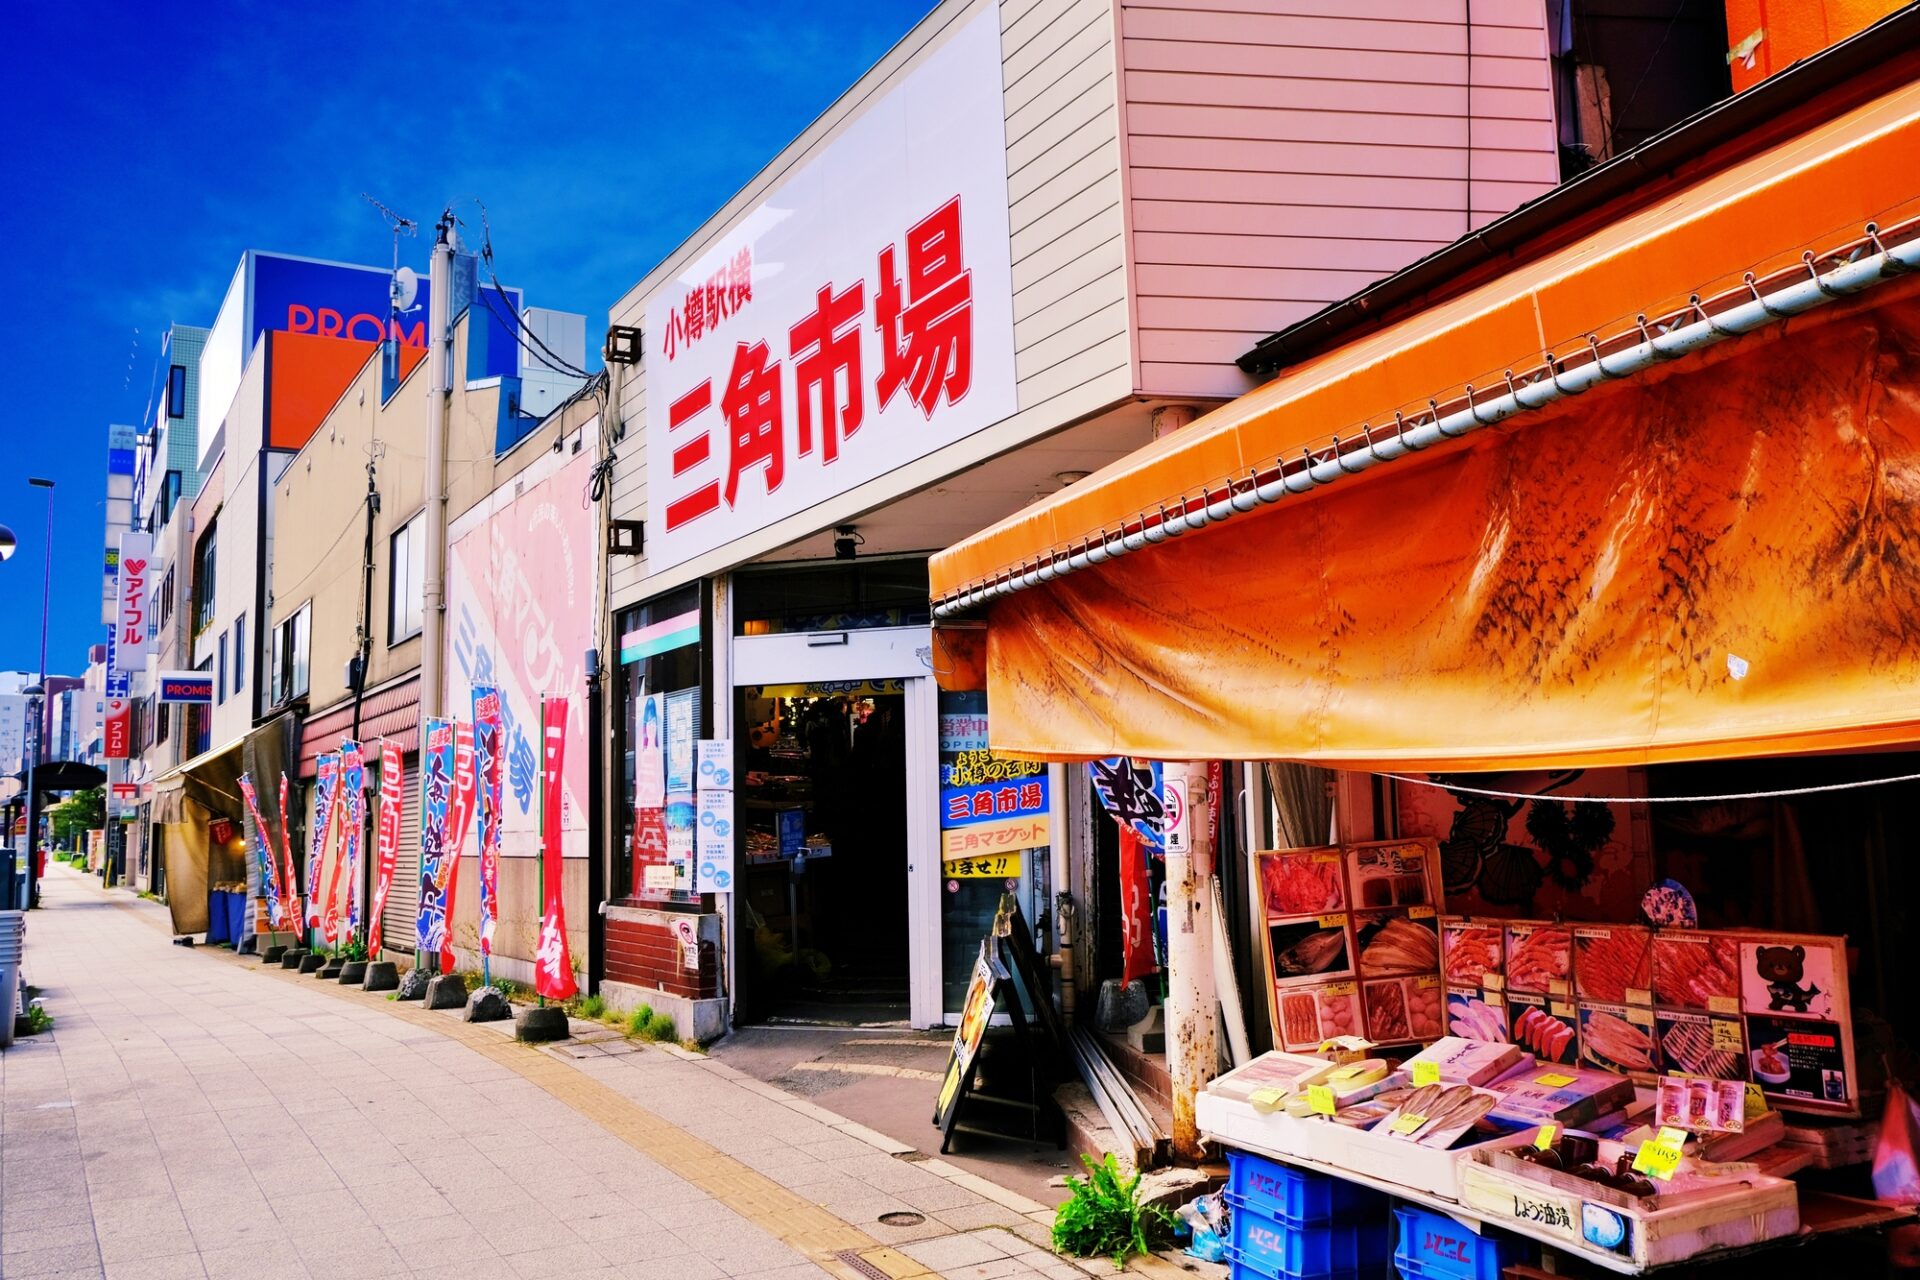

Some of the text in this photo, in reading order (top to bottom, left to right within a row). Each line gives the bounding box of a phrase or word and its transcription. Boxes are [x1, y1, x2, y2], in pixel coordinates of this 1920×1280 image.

[663, 245, 752, 361] 小樽駅横
[666, 193, 973, 533] 三角市場
[123, 577, 143, 645] アイフル
[111, 721, 123, 748] アコム
[940, 741, 986, 749] OPEN
[957, 750, 993, 765] ようこ
[948, 782, 1043, 819] 三角市場
[1513, 1194, 1572, 1230] しょう油漬
